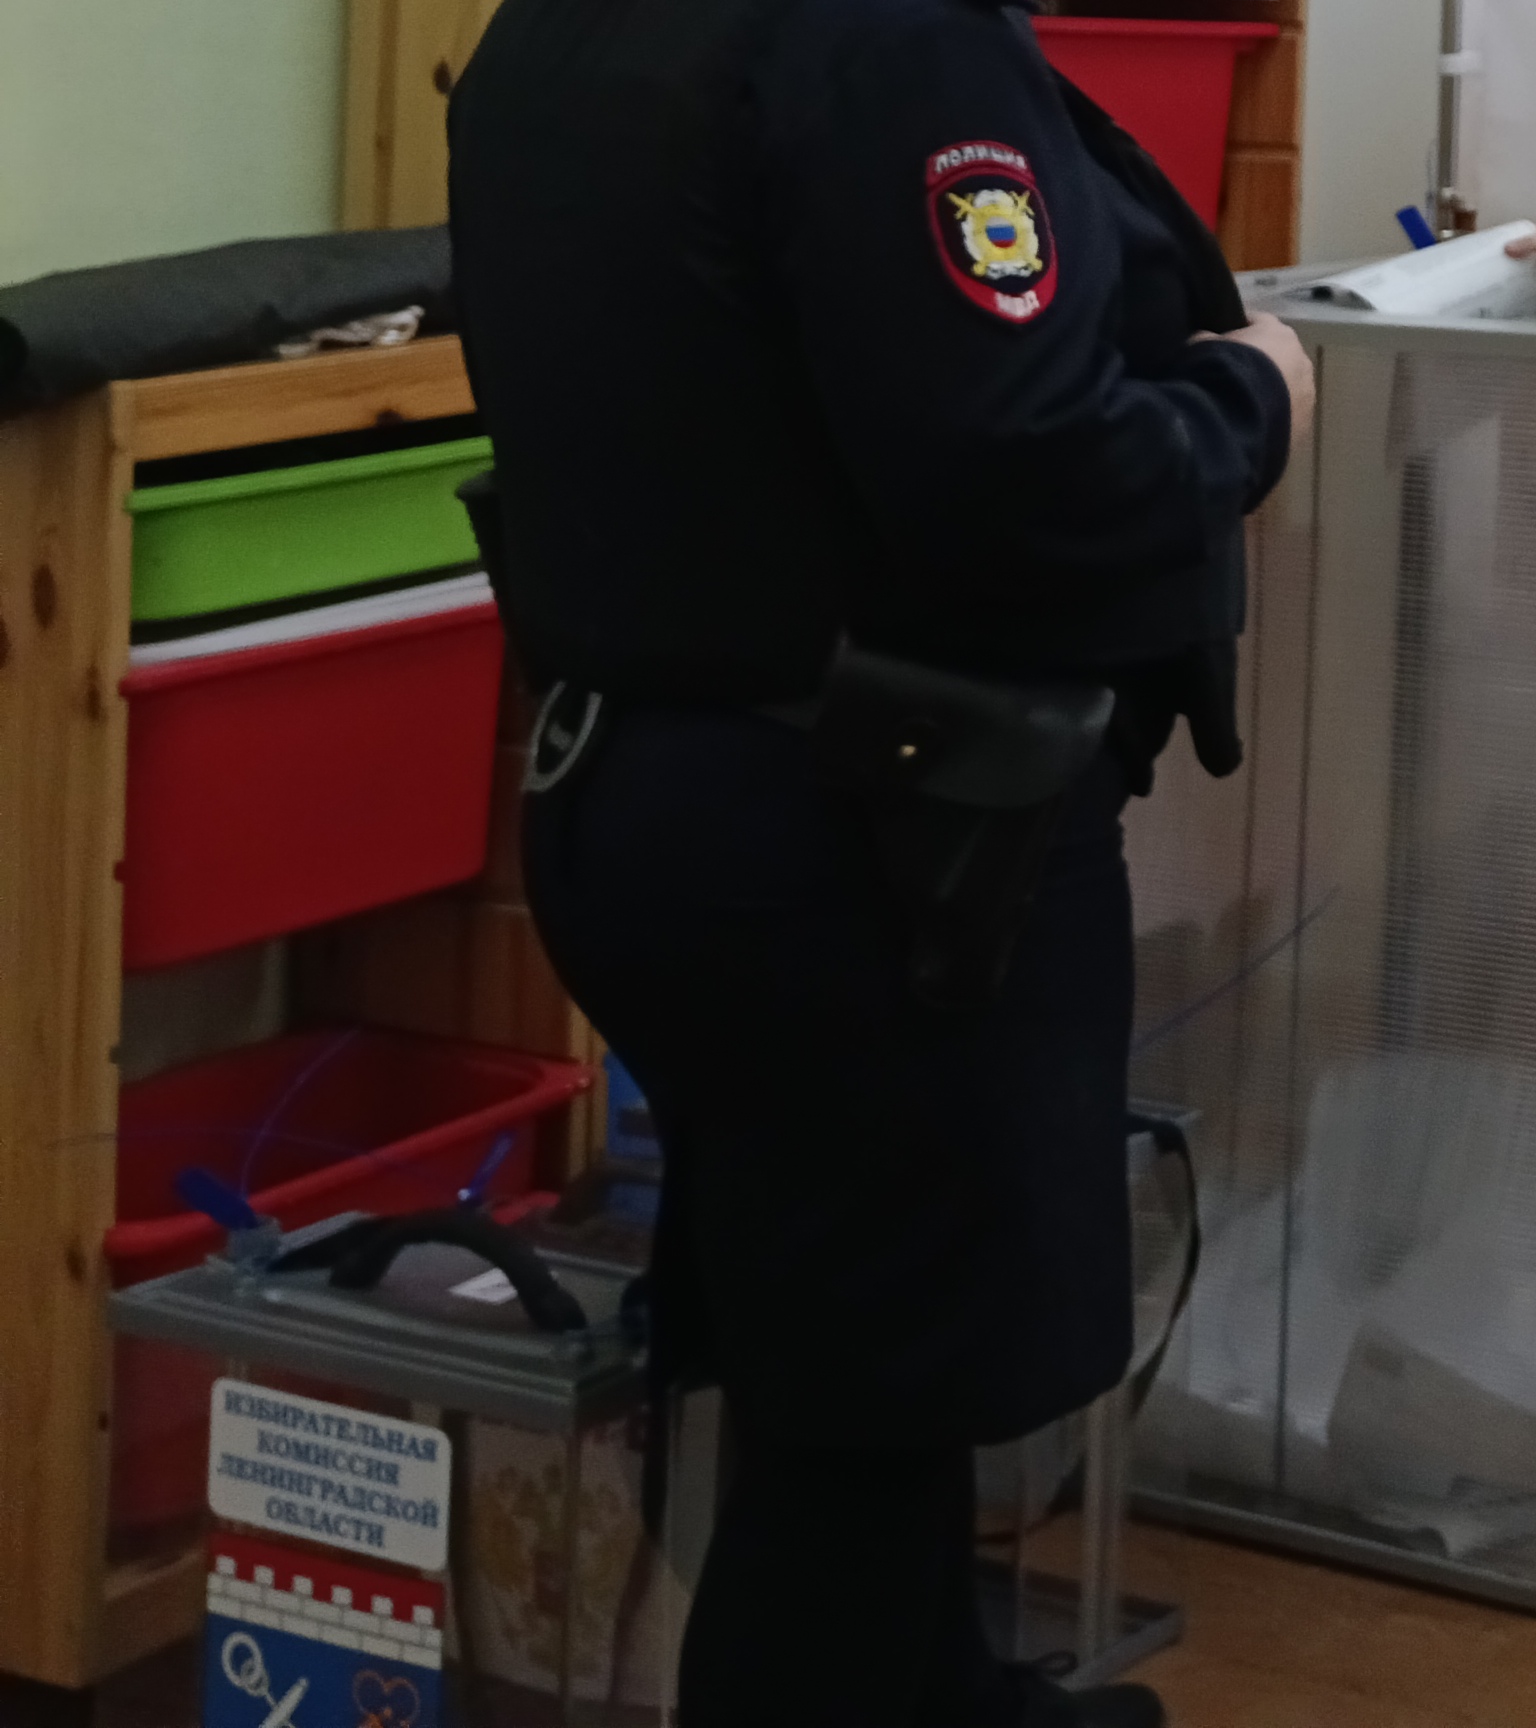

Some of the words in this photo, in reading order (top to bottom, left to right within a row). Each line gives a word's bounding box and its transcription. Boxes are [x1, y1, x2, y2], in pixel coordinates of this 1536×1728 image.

[224, 1390, 438, 1462] ИЗБИРАТЕЛЬНАЯ
[257, 1430, 400, 1486] КОМИССИЯ
[216, 1453, 438, 1529] ЛЕНИНГРАДСКОЙ
[265, 1496, 386, 1549] ОБЛАСТИ
